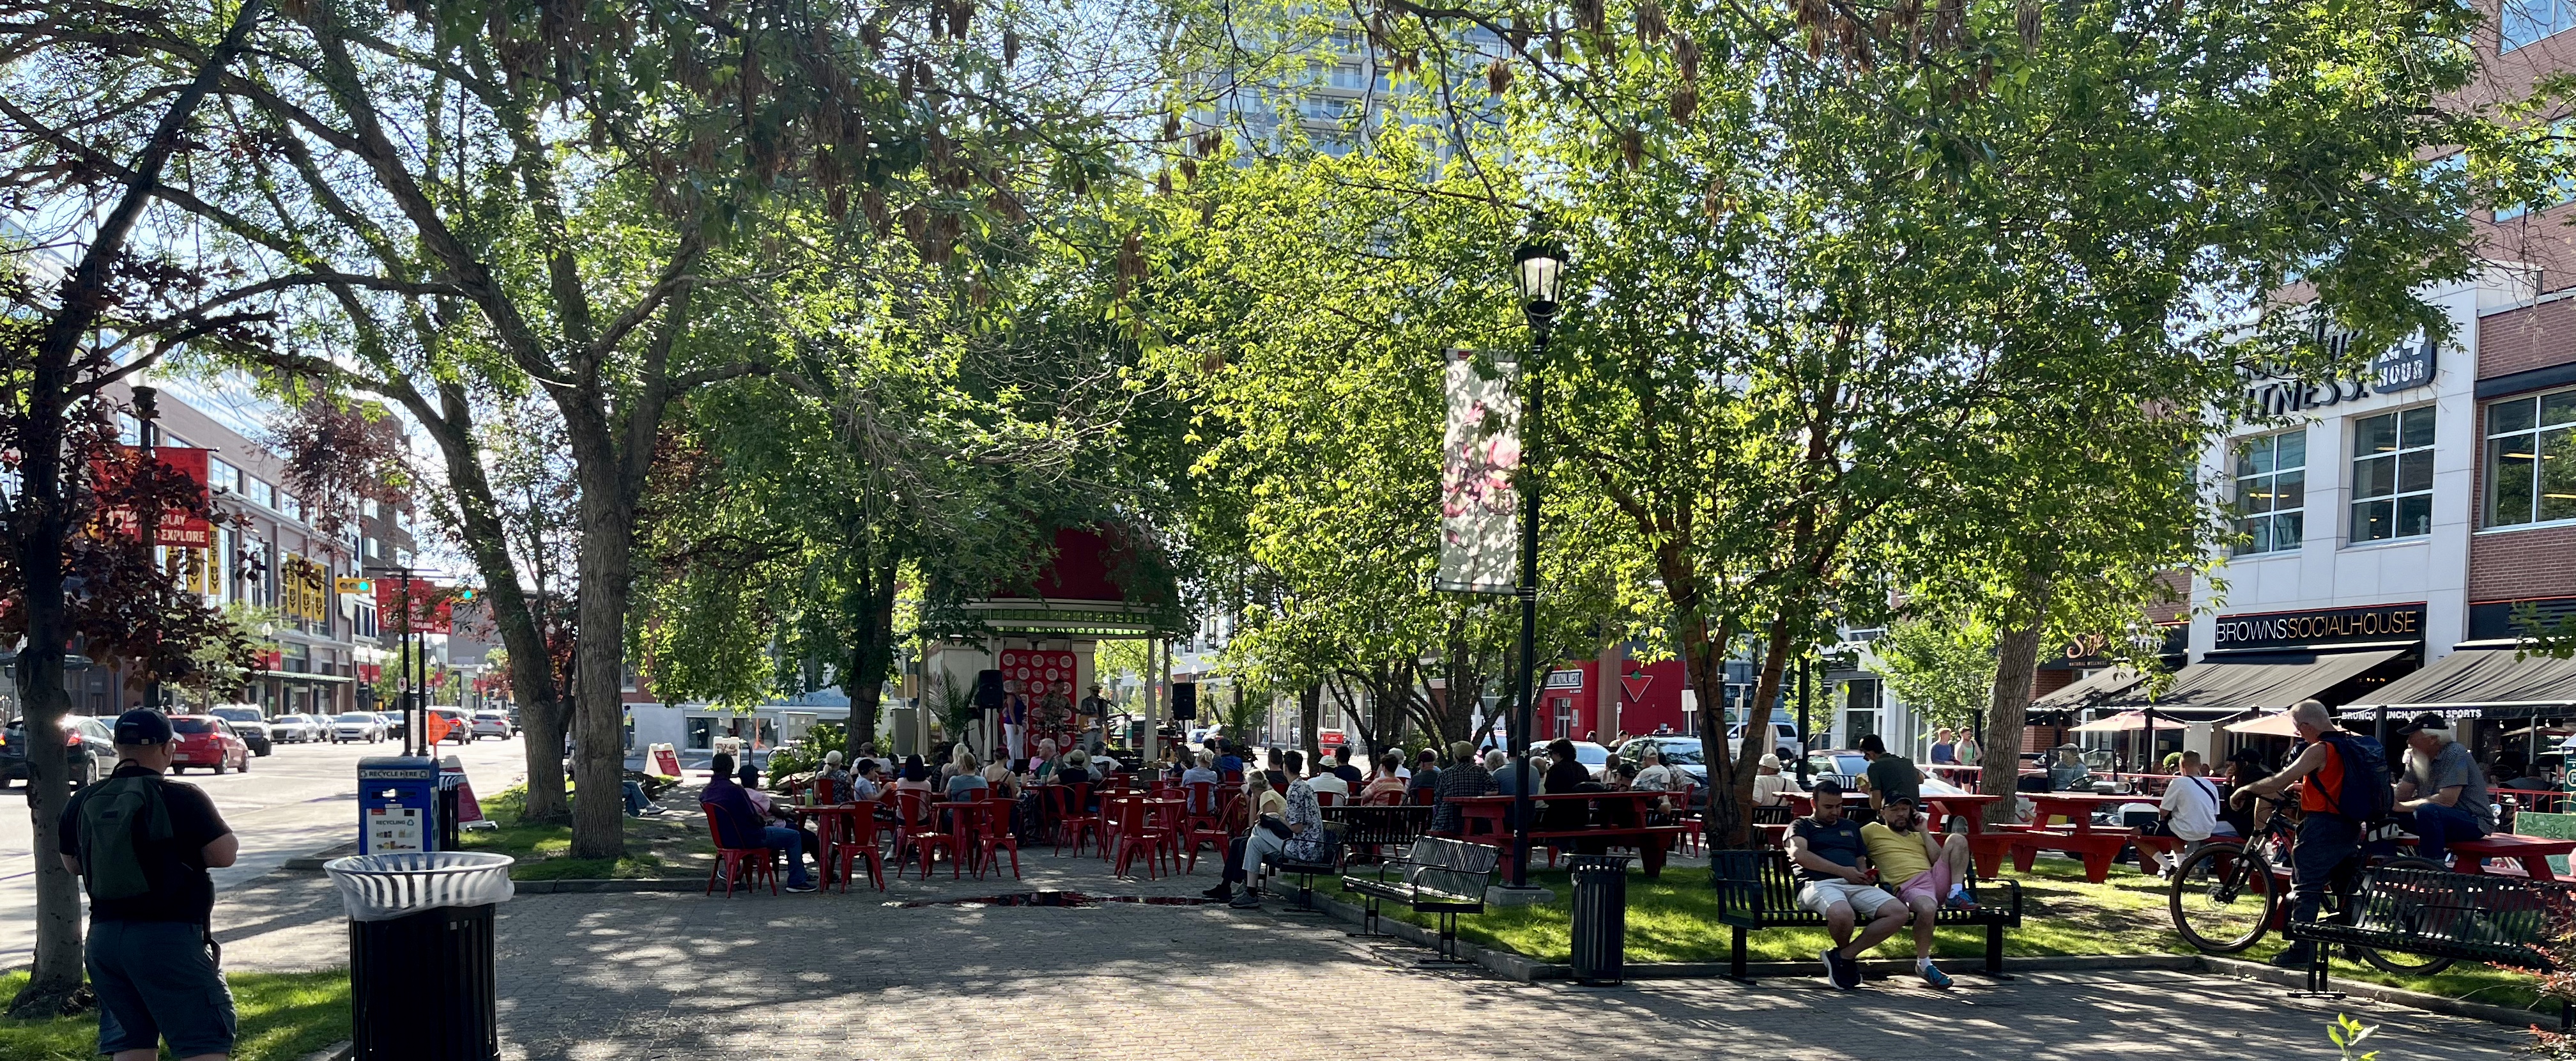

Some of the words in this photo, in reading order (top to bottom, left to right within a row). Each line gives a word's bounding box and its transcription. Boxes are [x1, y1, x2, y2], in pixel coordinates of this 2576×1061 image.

[2377, 359, 2424, 388] HOUR
[2225, 368, 2369, 424] ITNESS.
[160, 514, 186, 526] PLAY
[161, 529, 205, 543] EXPLORE
[210, 530, 218, 562] BEST
[210, 566, 218, 589] BUY
[2446, 709, 2482, 718] SPORTS
